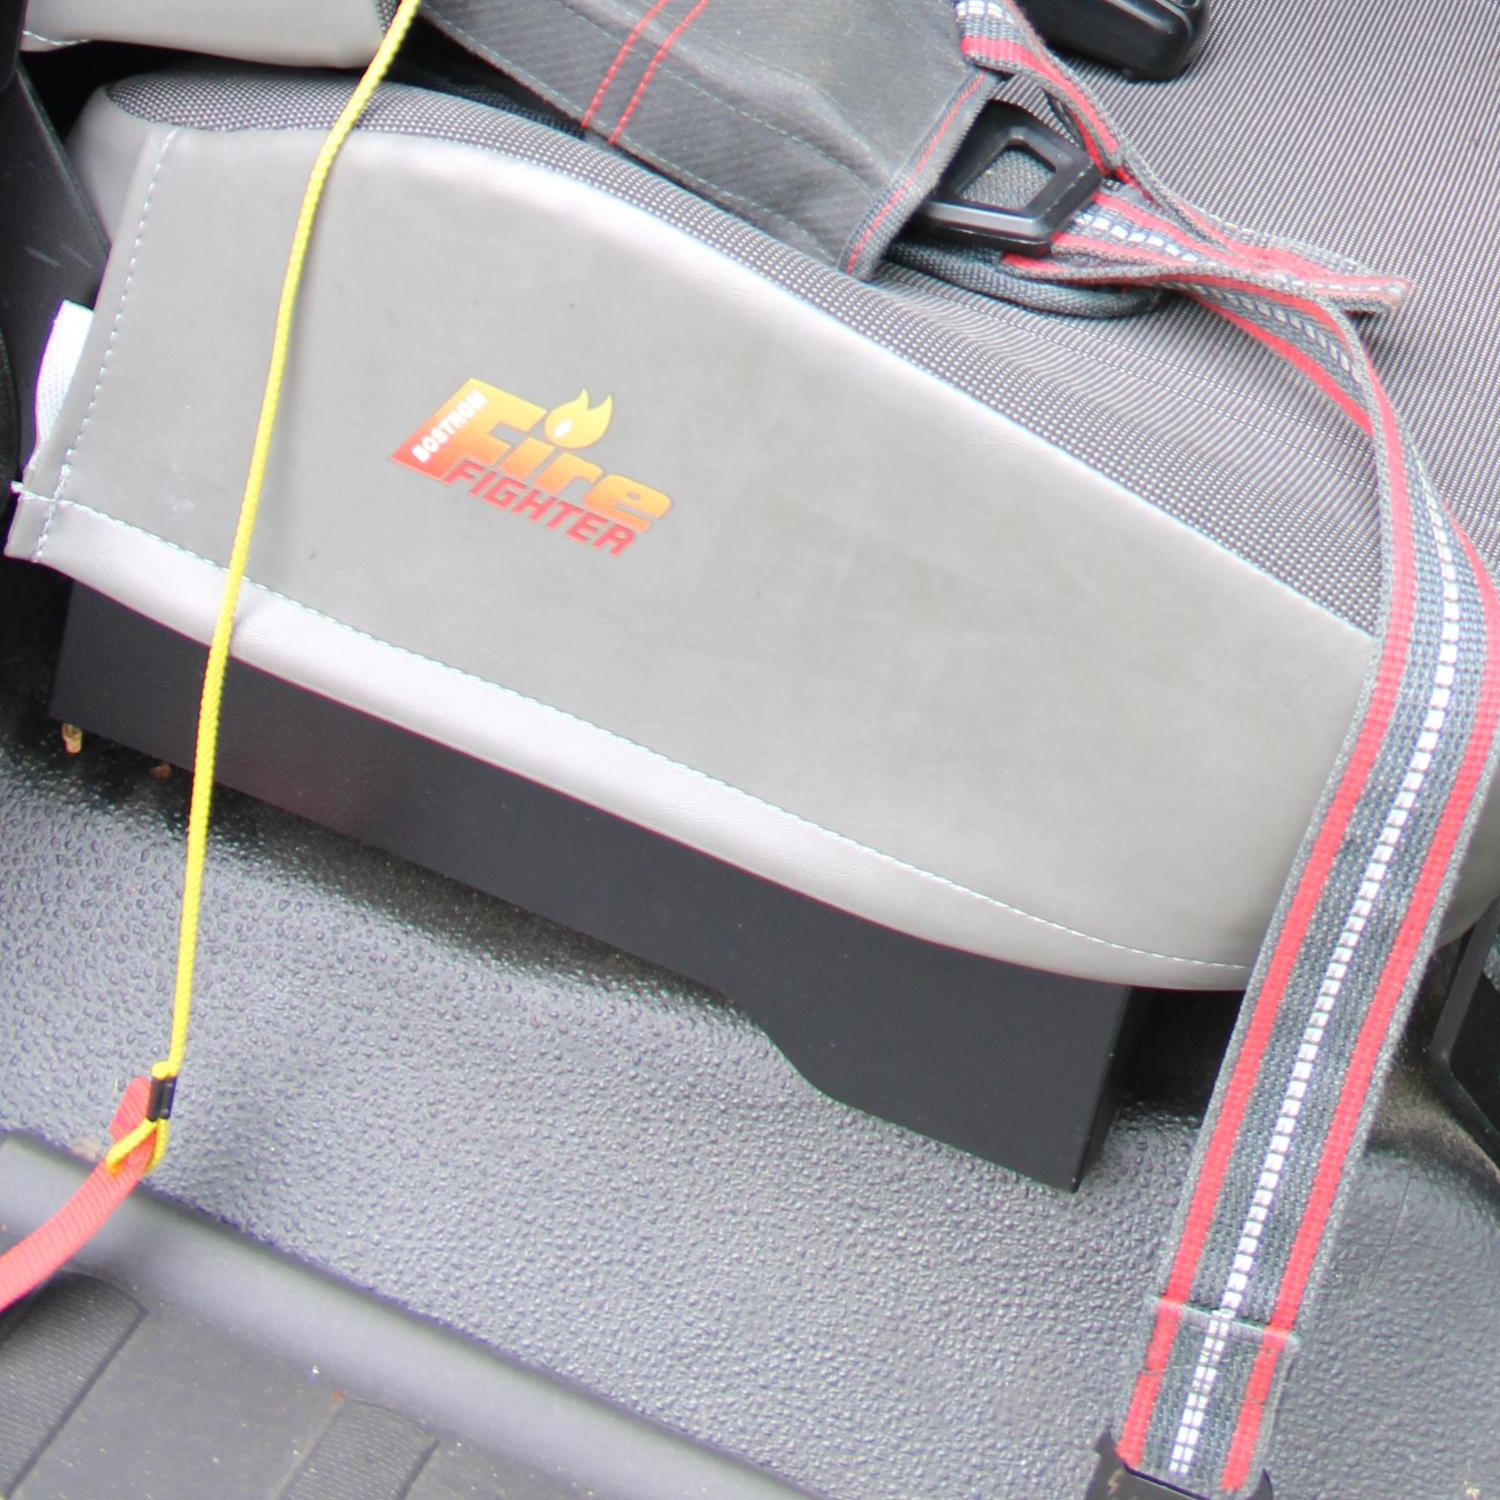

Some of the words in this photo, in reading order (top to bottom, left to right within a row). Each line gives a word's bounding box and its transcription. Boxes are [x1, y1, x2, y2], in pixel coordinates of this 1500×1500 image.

[390, 376, 672, 533] Fire
[411, 389, 488, 463] BOSTROM
[445, 459, 637, 558] FIGHTER
